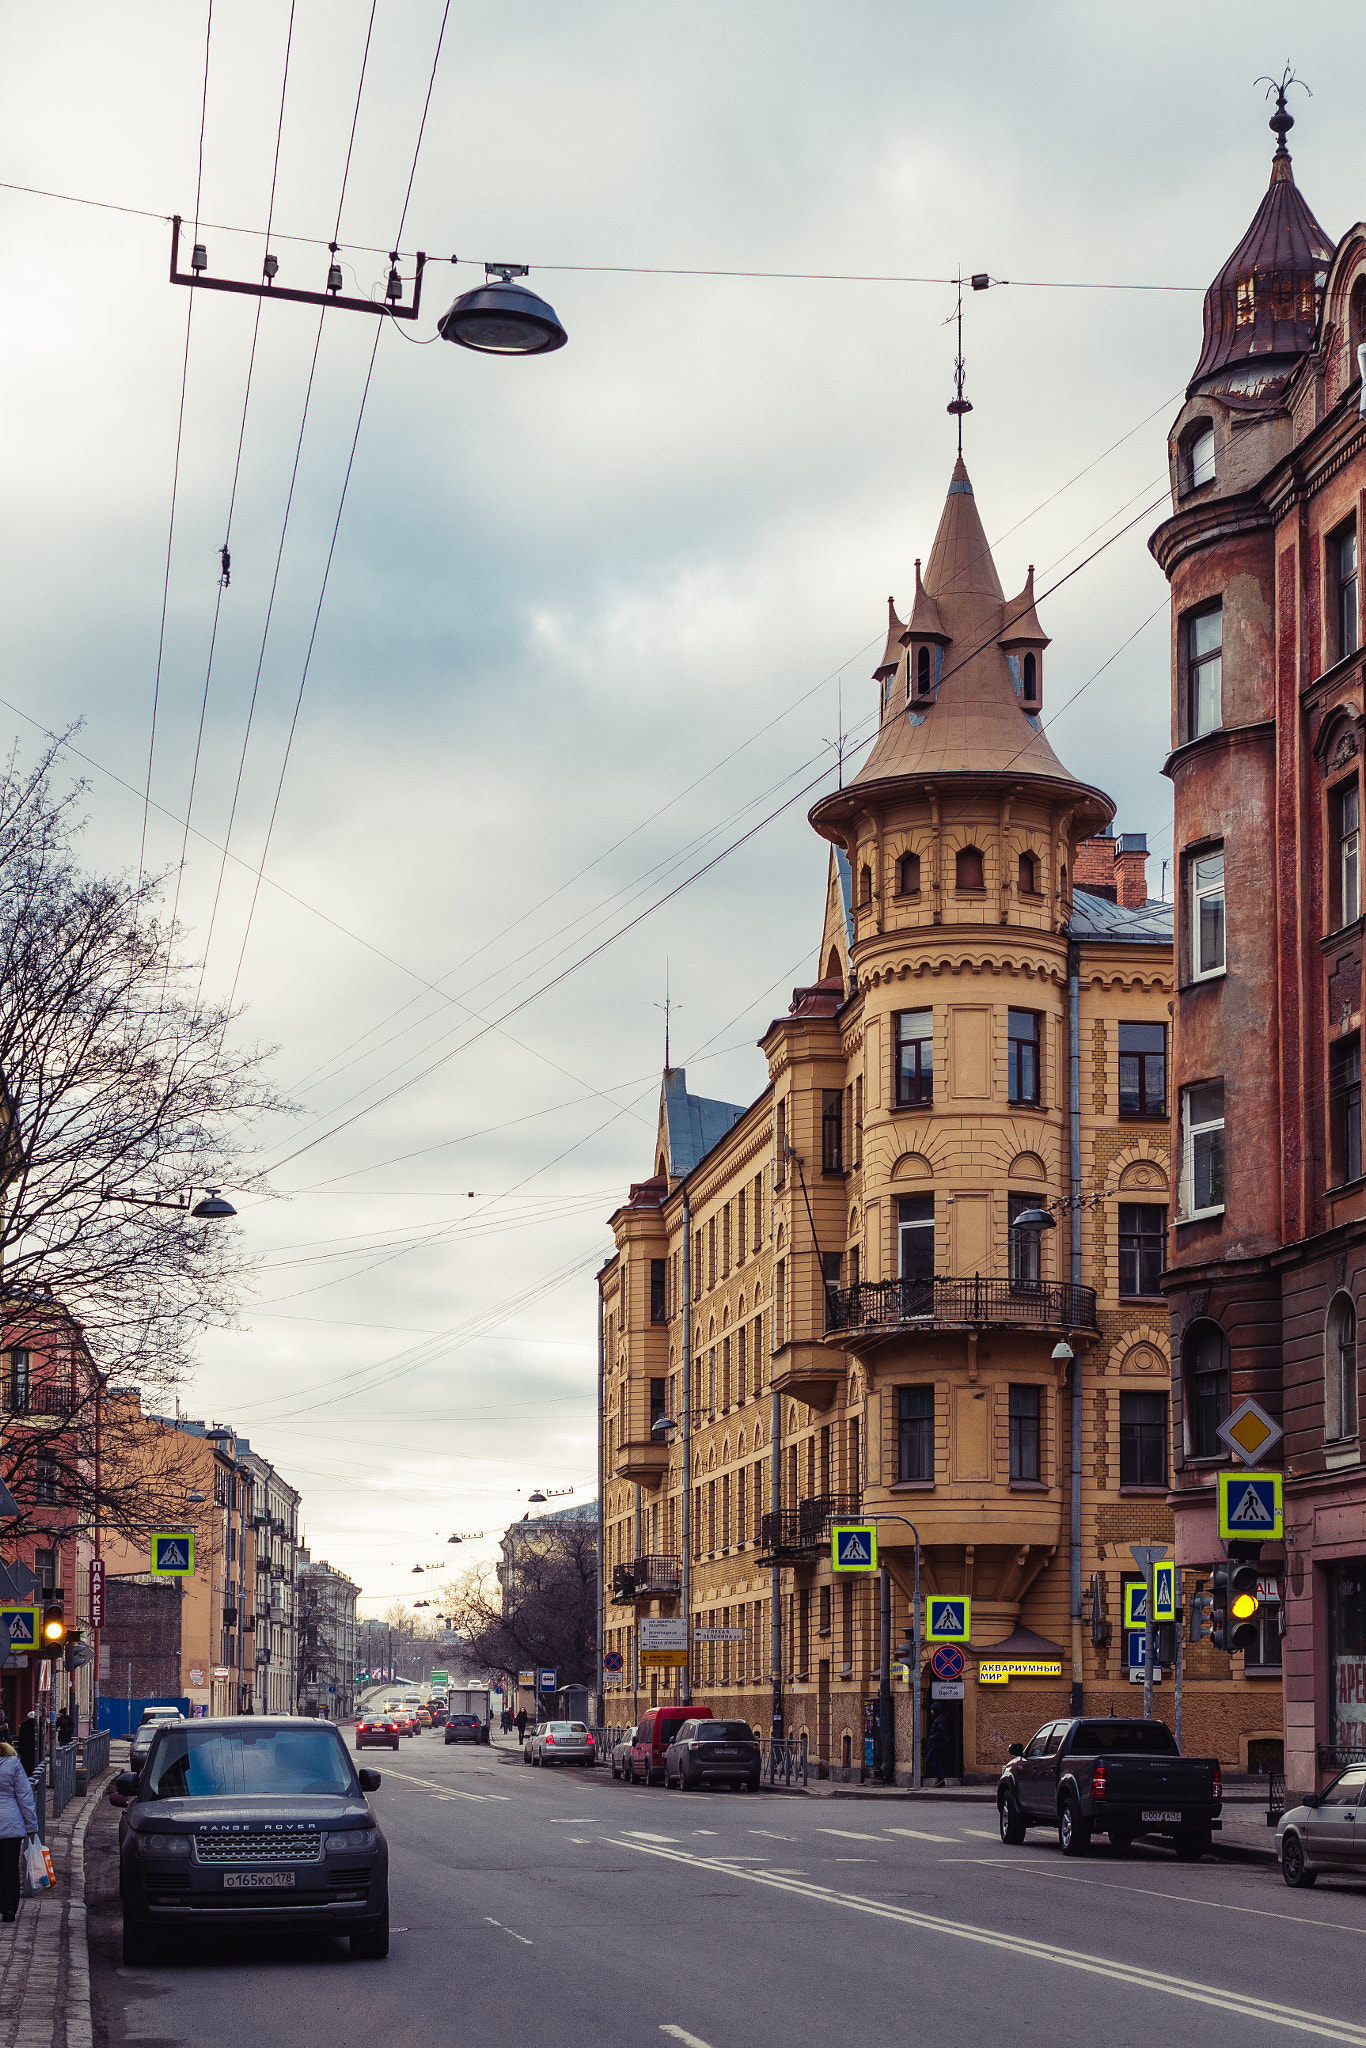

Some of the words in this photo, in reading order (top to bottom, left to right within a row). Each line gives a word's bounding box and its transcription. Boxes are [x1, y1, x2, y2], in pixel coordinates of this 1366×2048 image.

[92, 1561, 102, 1627] ПАРКЕТ
[981, 1663, 1060, 1673] АКВАРИУМНЫЙ
[980, 1673, 1003, 1681] МИР
